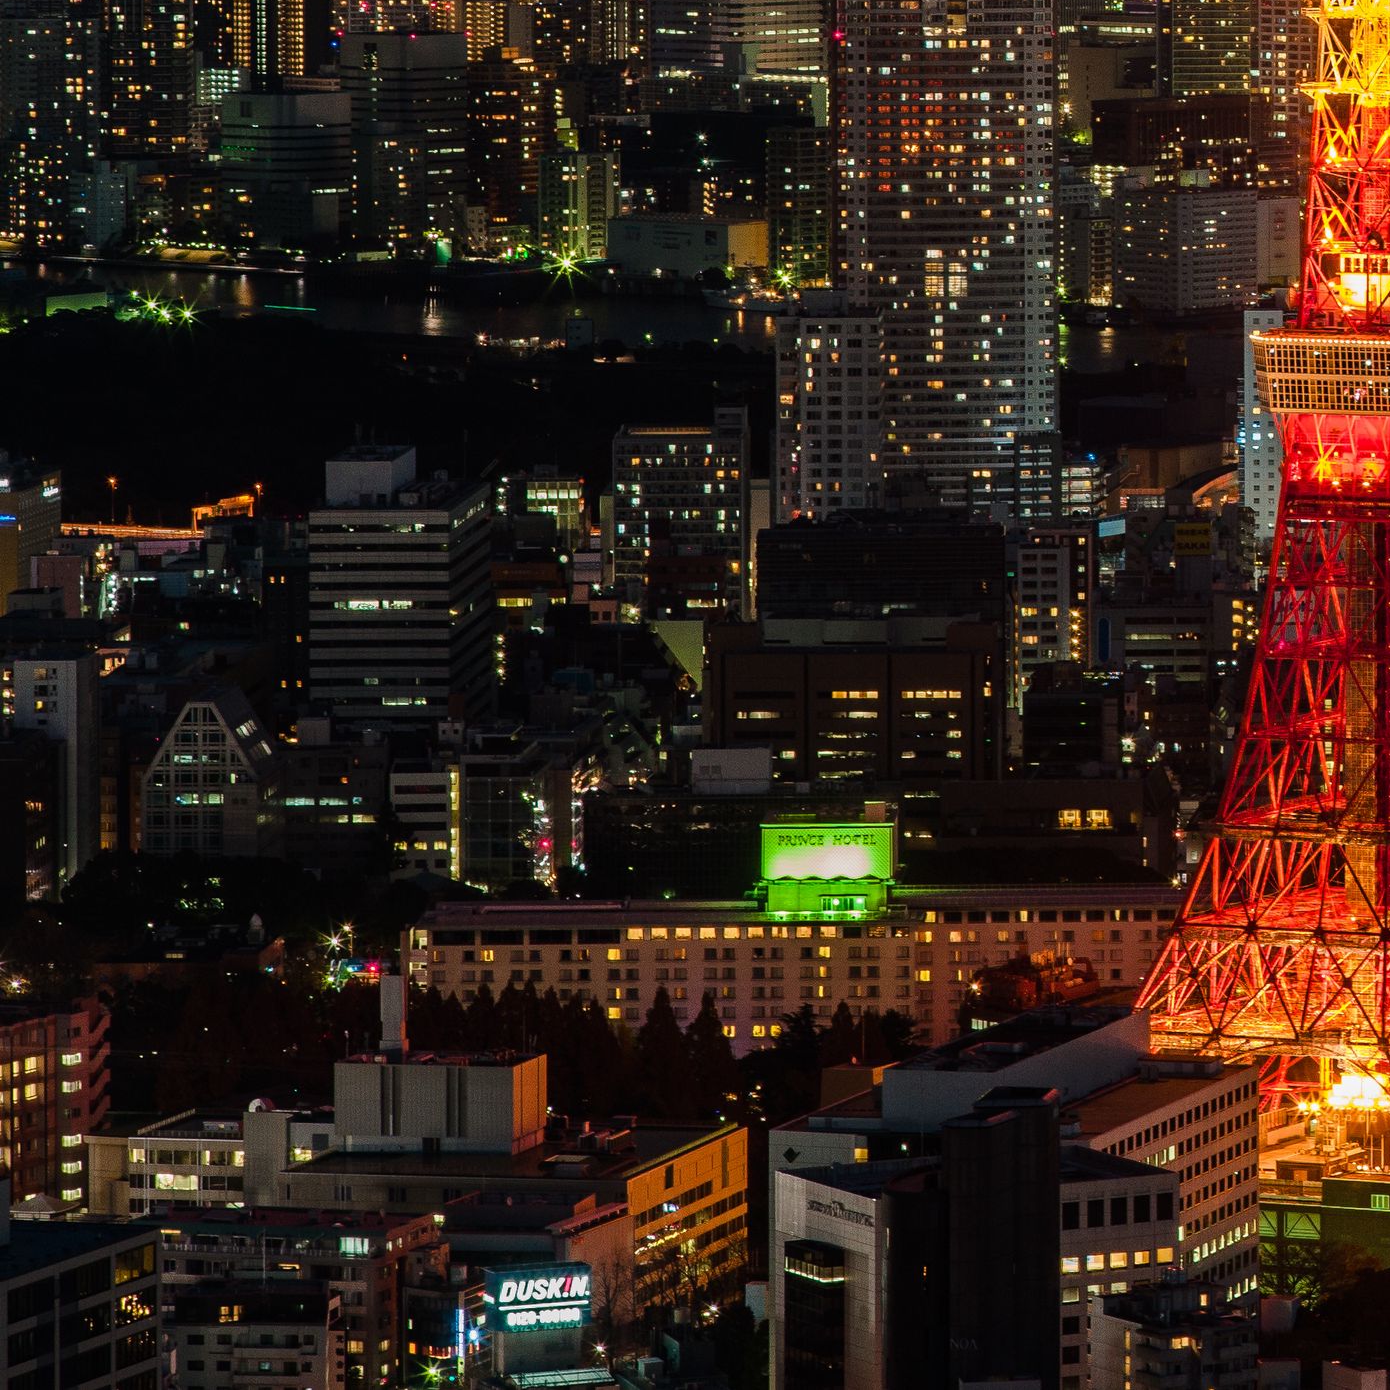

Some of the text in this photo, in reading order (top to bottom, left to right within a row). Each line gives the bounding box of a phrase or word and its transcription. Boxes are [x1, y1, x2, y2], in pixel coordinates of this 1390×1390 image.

[778, 834, 876, 846] PRINCE HOTEL
[949, 1337, 978, 1350] NOA
